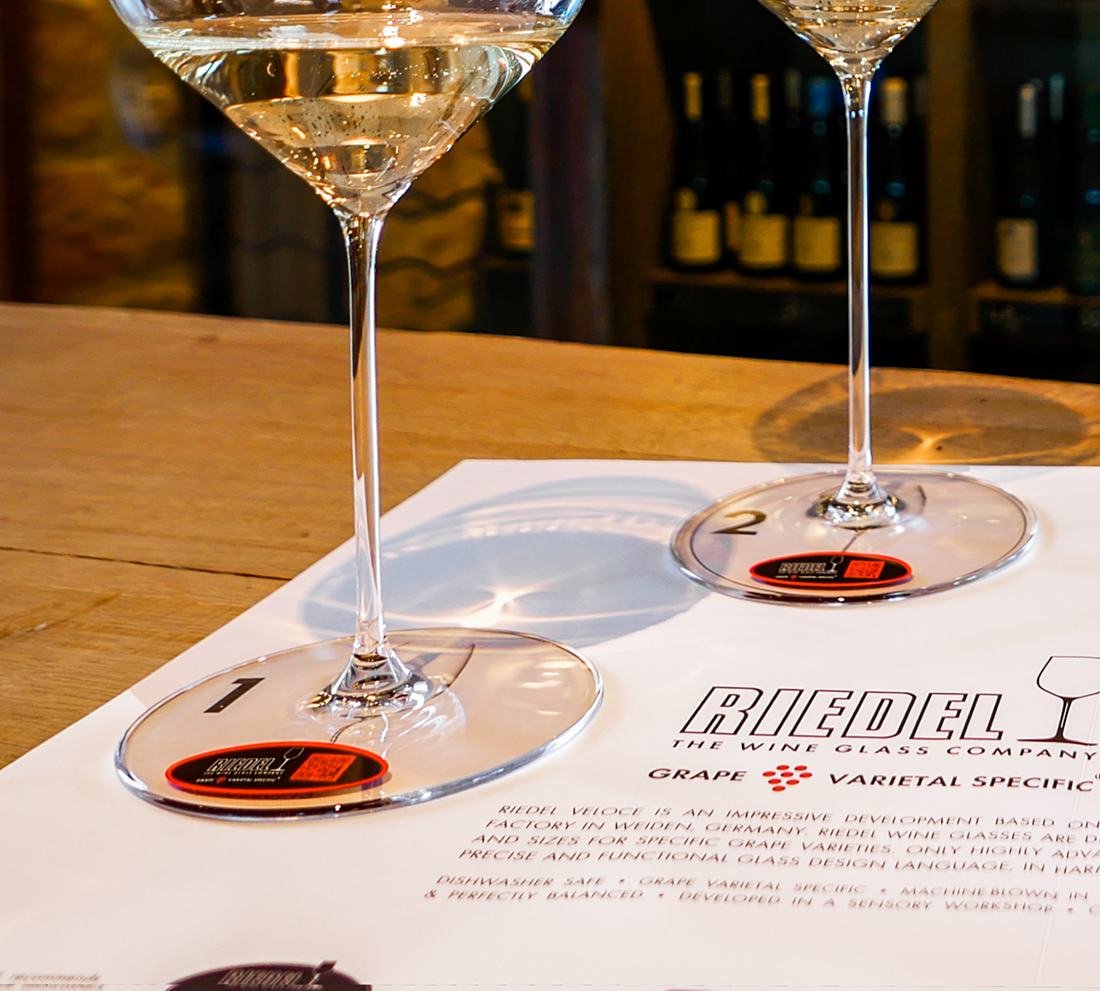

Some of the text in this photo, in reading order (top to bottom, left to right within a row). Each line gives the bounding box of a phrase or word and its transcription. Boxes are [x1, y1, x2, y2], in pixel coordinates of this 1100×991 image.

[710, 510, 767, 536] 2
[203, 677, 266, 713] 1
[679, 686, 1004, 741] RIEDEL
[672, 739, 1098, 761] THE WINE GLASS COMPANY
[648, 768, 748, 782] GRAPE
[828, 773, 962, 787] VARIETAL
[498, 805, 557, 815] RIEDEL
[572, 806, 644, 816] VELOCE
[655, 807, 672, 816] IS
[682, 807, 714, 817] AN
[726, 808, 832, 822] IMPRESSIVE
[844, 814, 984, 826] DEVELOPMENT
[995, 816, 1056, 827] BASED
[1068, 820, 1100, 829] ON
[486, 819, 575, 830] FACTORY
[582, 821, 606, 831] IN
[614, 821, 695, 832] WEIDEN,
[818, 828, 878, 838] RIEDEL
[888, 830, 941, 840] WINE
[949, 830, 1032, 841] GLASSES
[1041, 833, 1076, 844] ARE
[471, 834, 519, 845] AND
[527, 835, 579, 846] SIZES
[588, 835, 629, 846] FOR
[636, 836, 720, 847] SPECIFIC
[728, 838, 792, 850] GRAPE
[906, 845, 962, 856] ONLY
[970, 845, 1045, 857] HIGHLY
[458, 849, 538, 860] PRECISE
[542, 851, 590, 861] AND
[598, 851, 728, 862] FUNCTIONAL
[737, 855, 799, 866] GLASS
[809, 857, 886, 869] DESIGN
[1023, 863, 1046, 873] IN
[436, 875, 554, 887] DISHWASHER
[564, 876, 606, 886] SAFE
[639, 876, 696, 888] GRAPE
[708, 879, 781, 891] VARIETAL
[792, 883, 867, 894] SPECIFIC
[1069, 891, 1088, 900] IN
[448, 890, 538, 901] PERFECTLY
[547, 889, 643, 900] BALANCED
[679, 891, 781, 905] DEVELOPED
[792, 897, 813, 906] IN
[823, 897, 836, 907] A
[848, 898, 933, 910] SENSORY
[945, 900, 1053, 912] WORKSHOP
